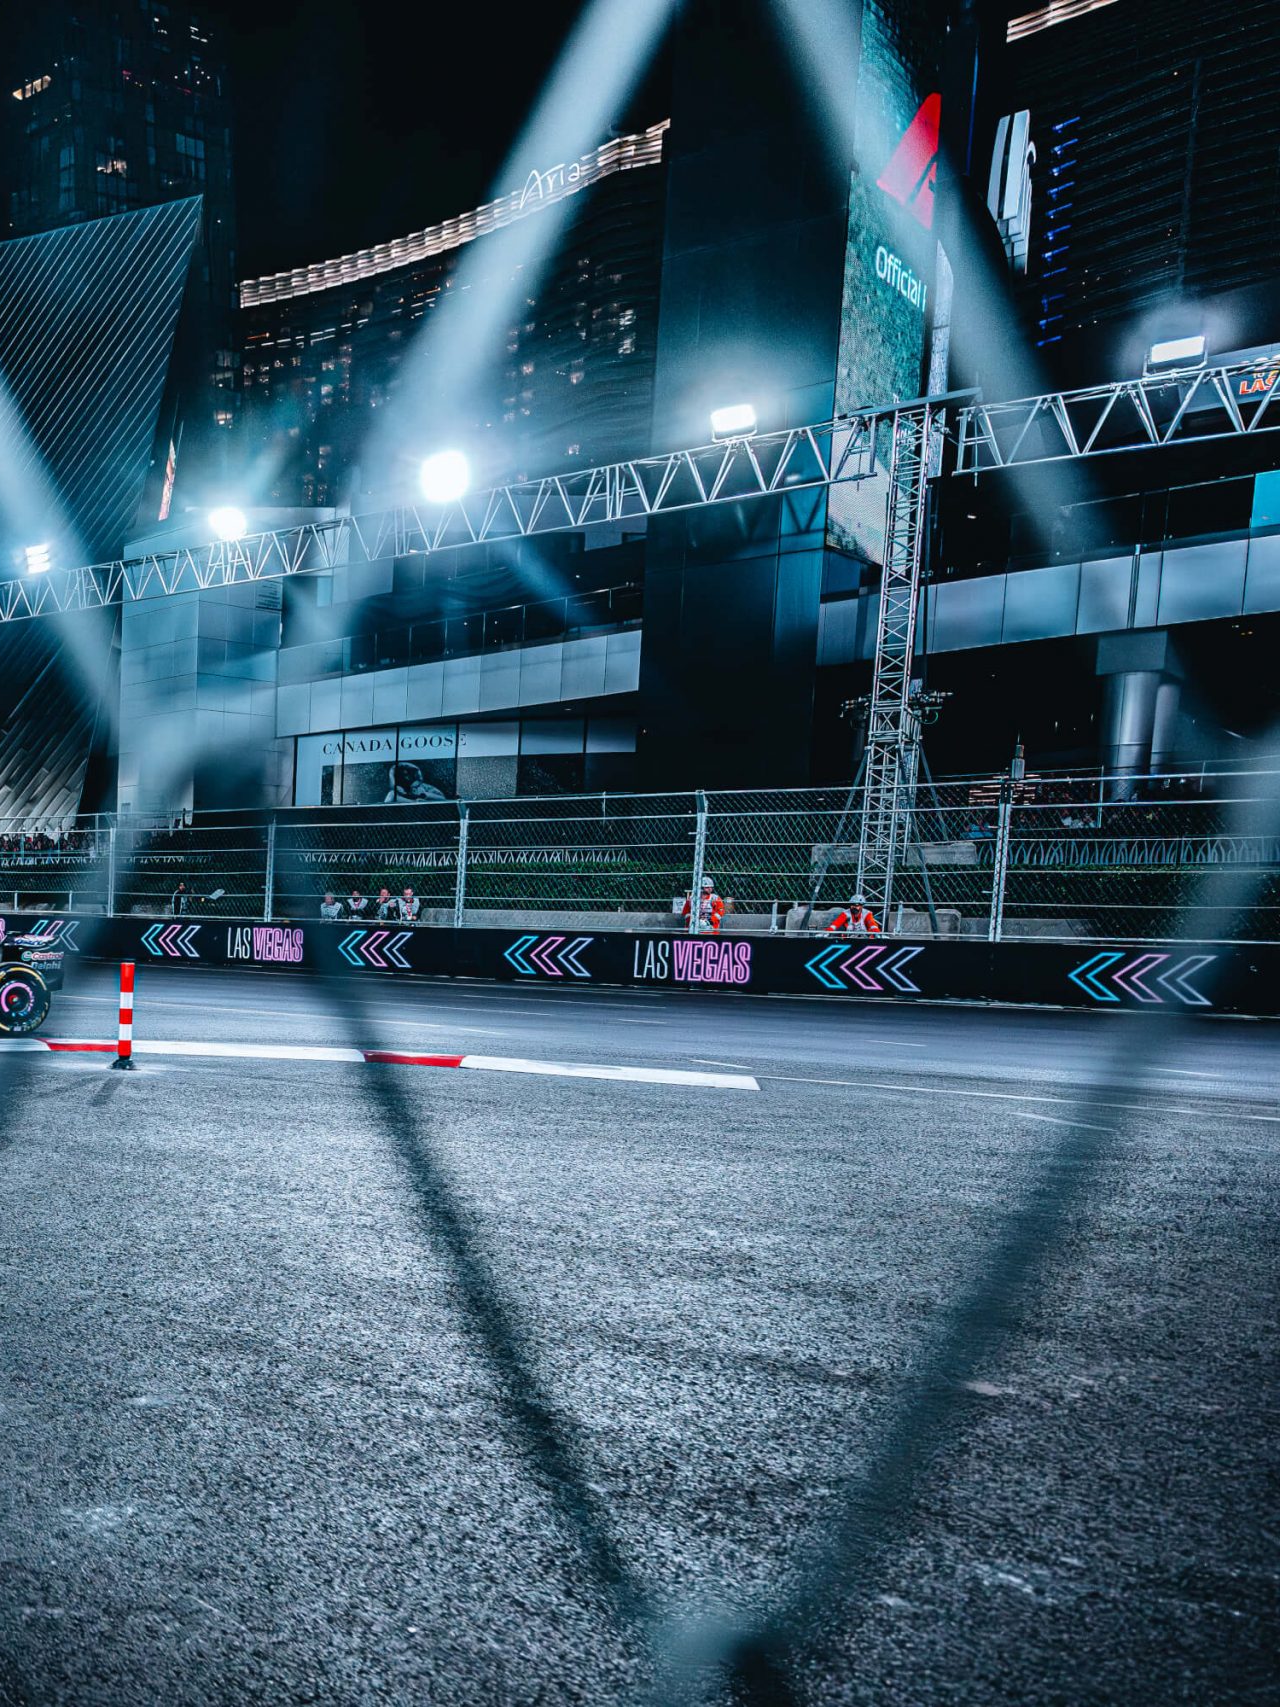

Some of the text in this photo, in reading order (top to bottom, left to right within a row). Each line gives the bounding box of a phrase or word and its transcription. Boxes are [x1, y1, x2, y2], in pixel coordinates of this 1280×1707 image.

[520, 163, 580, 209] Aria
[876, 246, 922, 308] Official
[322, 733, 467, 755] CANADA GOOSE
[227, 927, 304, 962] LAS VEGAS
[633, 940, 751, 984] LAS VEGAS
